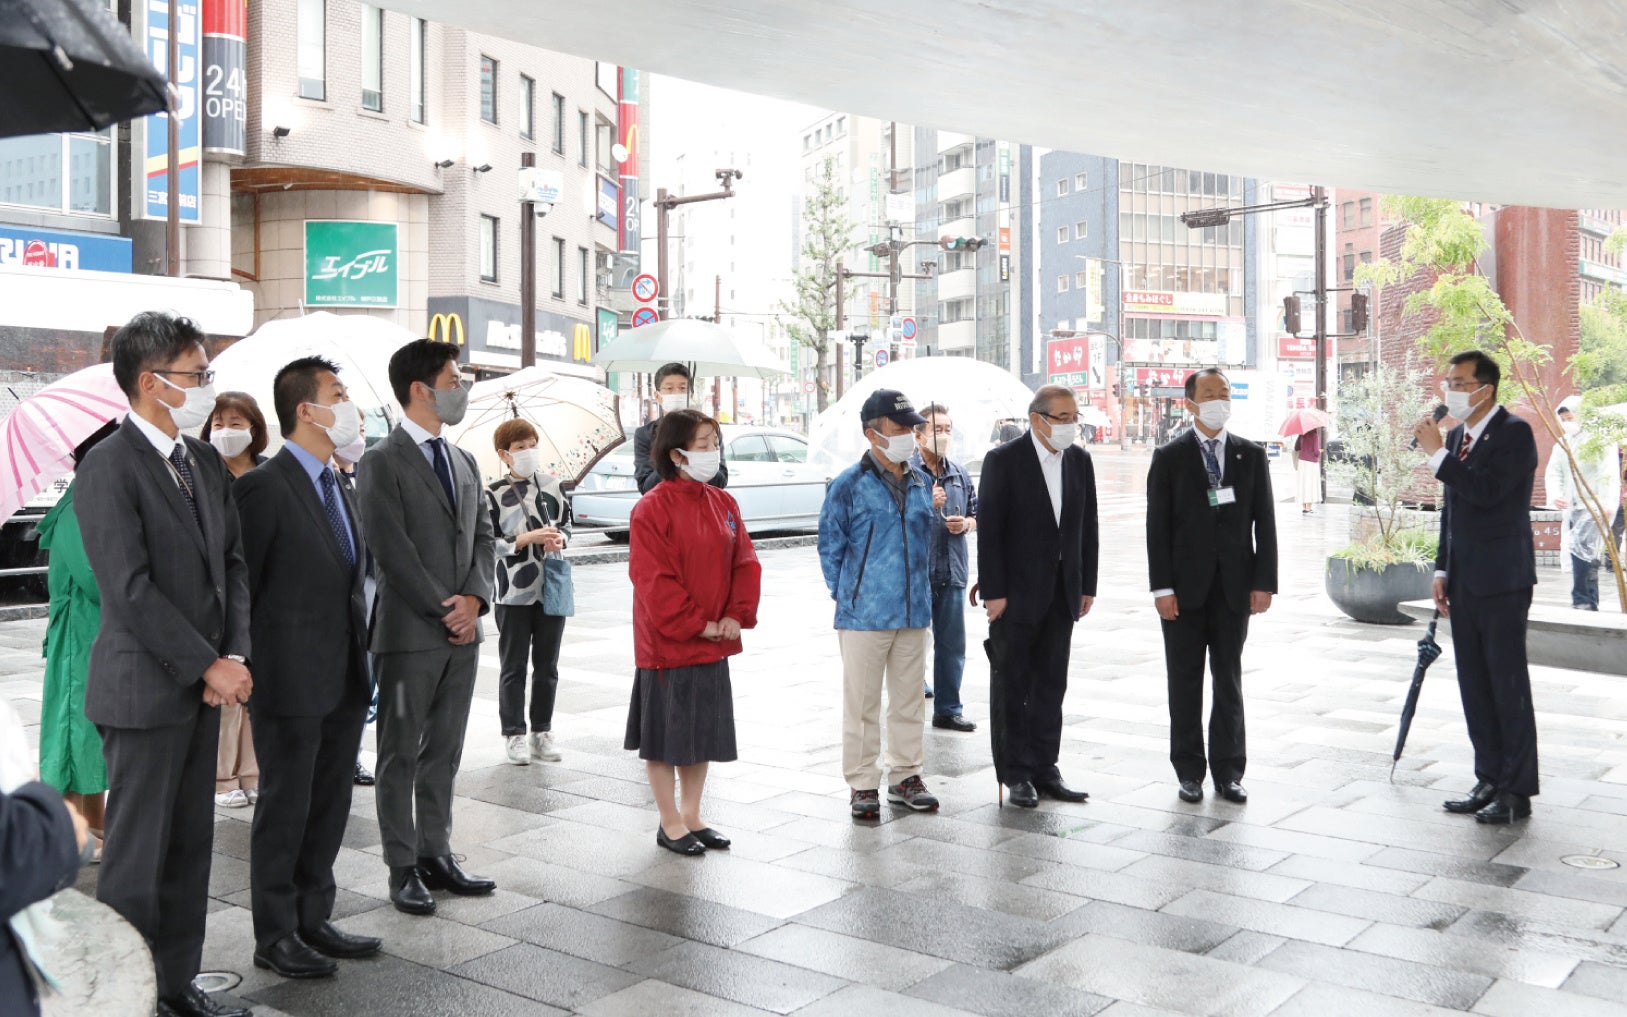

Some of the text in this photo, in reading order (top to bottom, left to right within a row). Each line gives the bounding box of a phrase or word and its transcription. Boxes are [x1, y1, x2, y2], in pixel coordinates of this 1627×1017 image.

[312, 249, 391, 279] エイブル
[54, 478, 69, 494] 学
